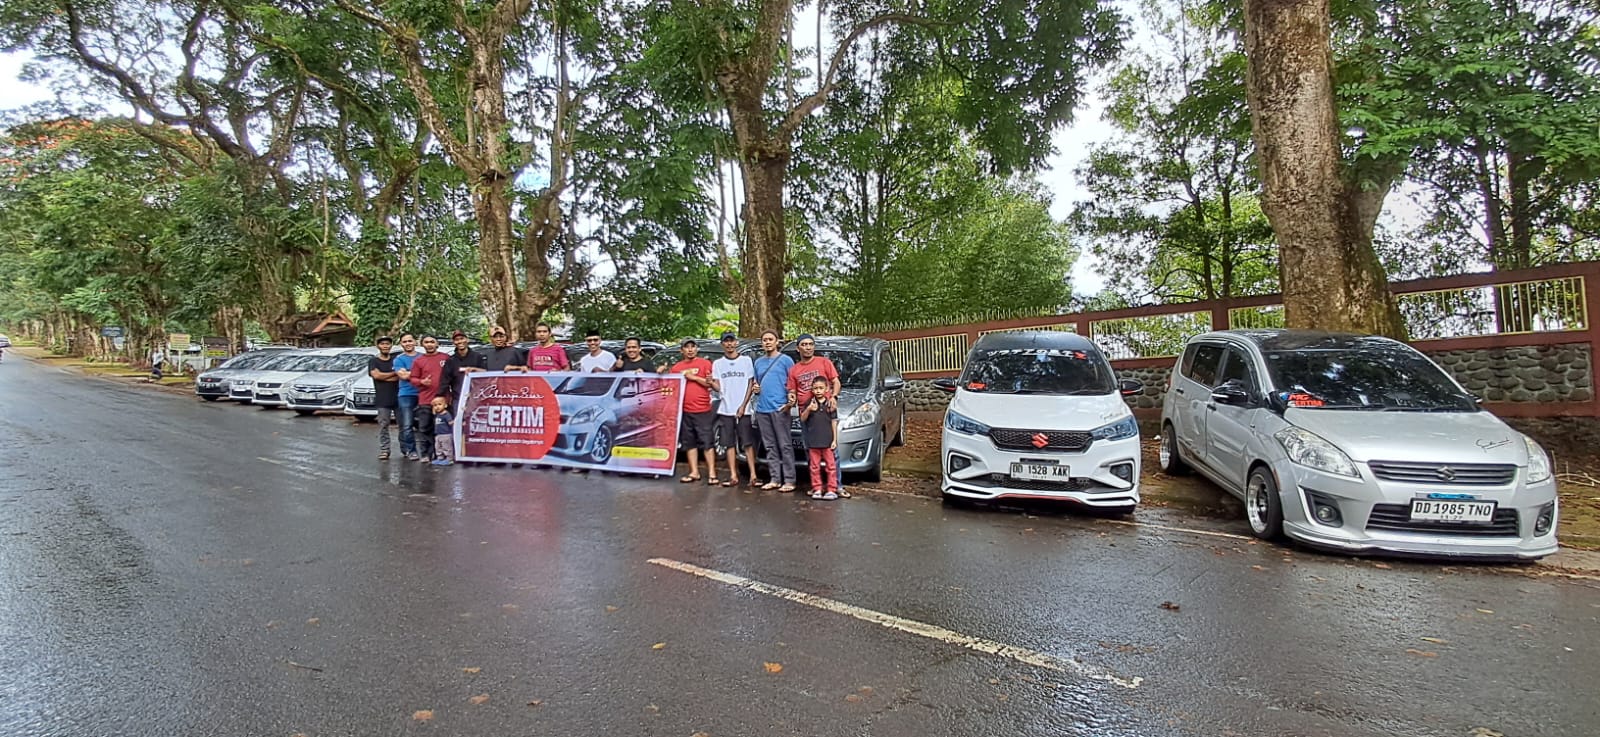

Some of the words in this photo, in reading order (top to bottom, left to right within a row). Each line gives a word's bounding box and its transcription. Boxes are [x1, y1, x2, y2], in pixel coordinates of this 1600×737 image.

[1012, 464, 1023, 473] DD
[1028, 465, 1047, 475] 1528
[1052, 466, 1067, 477] XAK
[1415, 502, 1431, 513] DD
[1433, 503, 1465, 515] 1985
